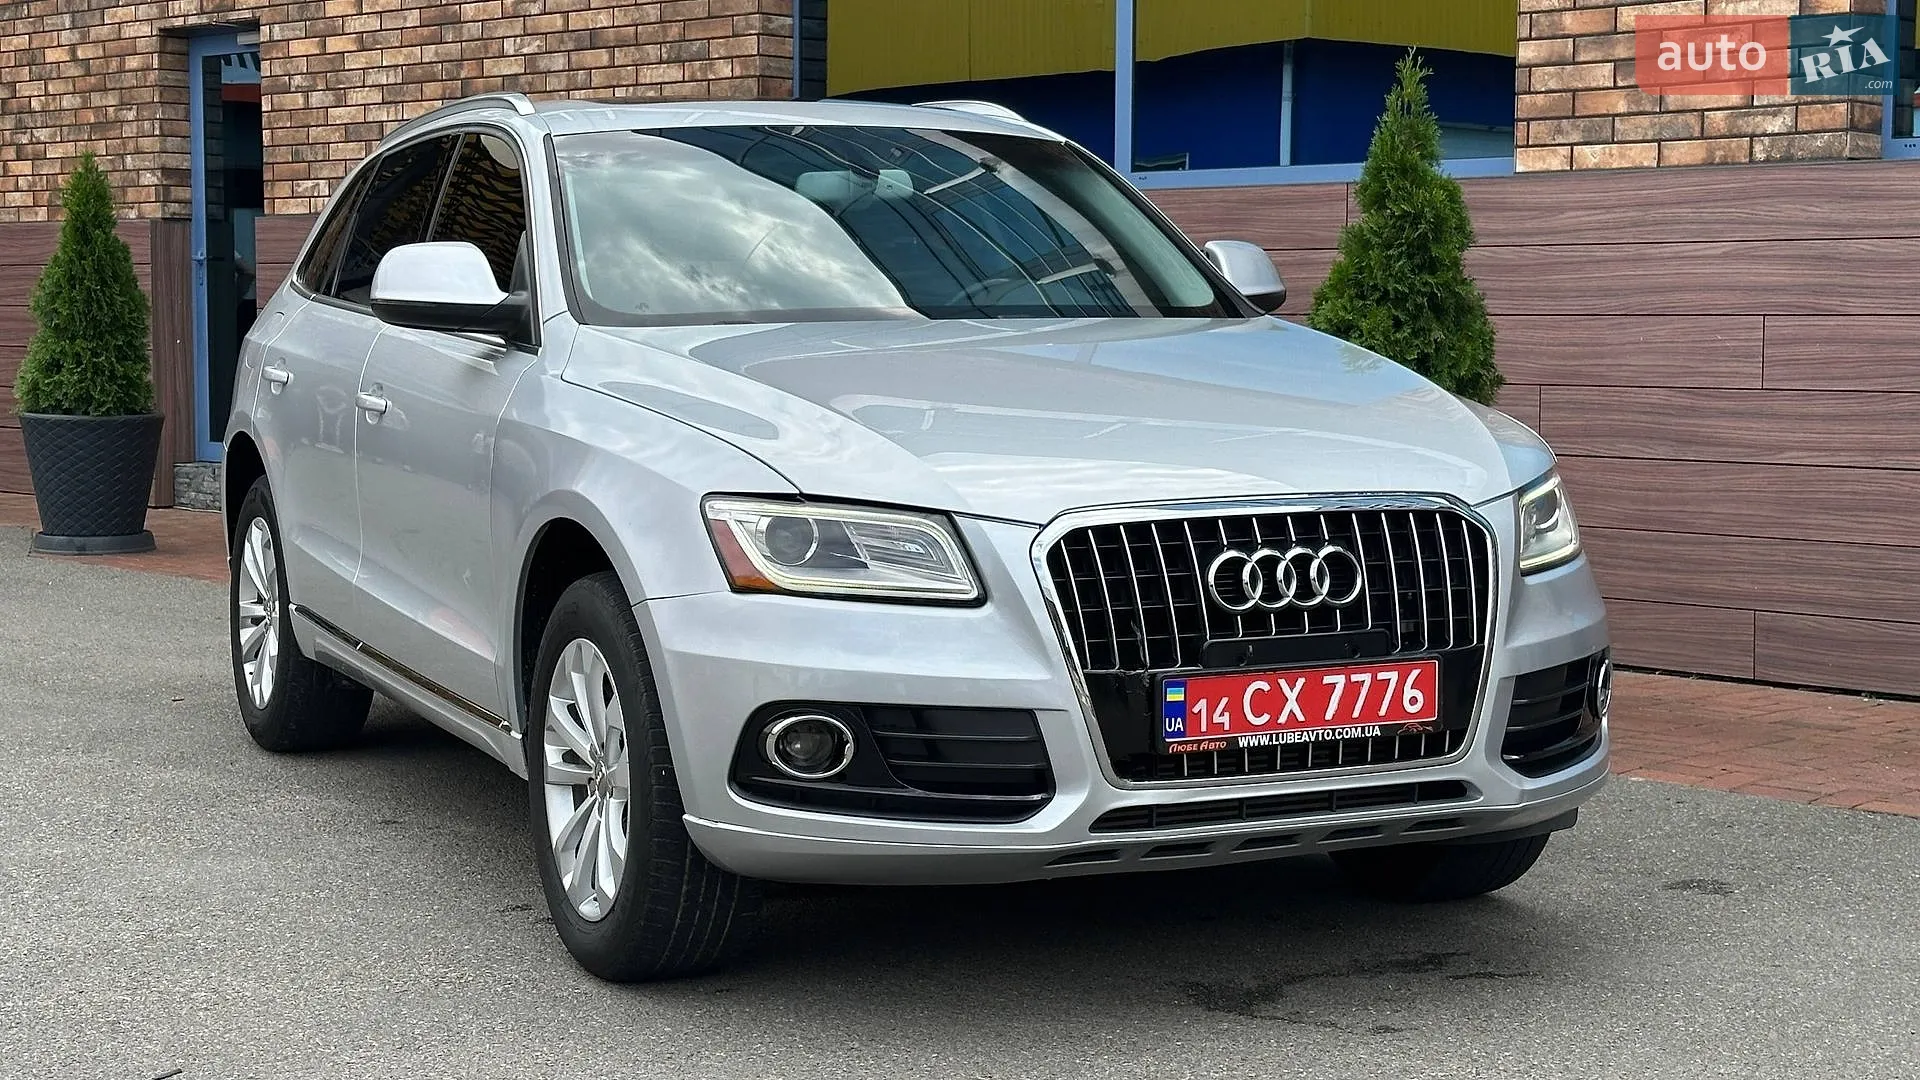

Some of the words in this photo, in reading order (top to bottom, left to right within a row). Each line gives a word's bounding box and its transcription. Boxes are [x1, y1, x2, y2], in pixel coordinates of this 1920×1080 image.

[1191, 697, 1230, 733] 14
[1243, 677, 1306, 726] CX
[1322, 669, 1425, 721] 7776
[1165, 717, 1184, 732] UA
[1238, 725, 1381, 748] WWW.LUBEAVTO.COM.UA
